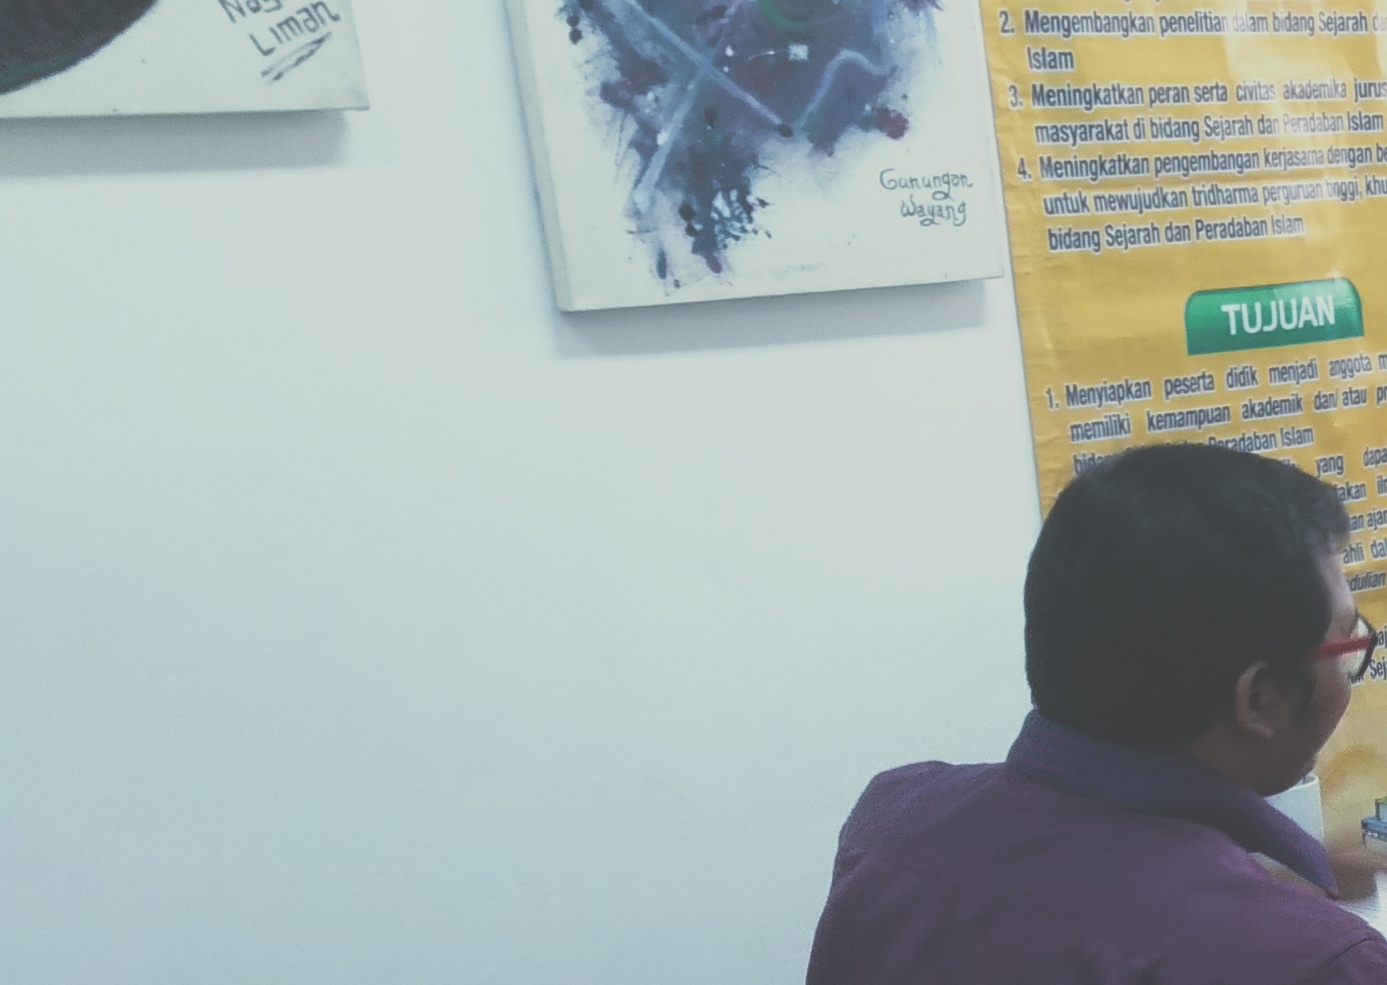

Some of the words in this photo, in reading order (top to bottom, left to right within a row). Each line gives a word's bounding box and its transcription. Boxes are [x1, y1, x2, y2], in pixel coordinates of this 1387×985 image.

[1000, 11, 1015, 33] 2.
[1024, 10, 1155, 38] Mengembangkan
[1159, 12, 1227, 37] penelitian
[1232, 12, 1268, 33] dalam
[1273, 12, 1315, 36] bidang
[1319, 11, 1368, 36] Sejarah
[1026, 47, 1075, 70] Islam
[1008, 84, 1023, 107] 3.
[1031, 83, 1144, 111] Meningkatkan
[1149, 85, 1190, 108] peran
[1194, 82, 1228, 102] serta
[1236, 80, 1276, 101] civitas
[1282, 78, 1347, 100] akademika
[1035, 119, 1130, 147] masyarakat
[1133, 117, 1145, 139] di
[1150, 117, 1200, 142] bidang
[1204, 115, 1253, 141] Sejarah
[1258, 114, 1280, 134] dan
[1283, 112, 1344, 133] Peradaban
[1347, 111, 1384, 131] Islam
[1017, 157, 1032, 179] 4.
[1039, 153, 1150, 181] Meningkatkan
[1154, 150, 1260, 177] pengembangan
[1263, 147, 1325, 171] kerjasama
[1327, 145, 1373, 168] dengan
[900, 193, 967, 227] Wayang
[1043, 190, 1091, 215] untuk
[1094, 187, 1189, 214] mewujudkan
[1191, 184, 1259, 207] tridharma
[1262, 182, 1324, 206] perguruan
[1326, 175, 1362, 202] tinggi,
[1047, 227, 1100, 252] bidang
[1105, 222, 1161, 250] Sejarah
[1165, 220, 1191, 243] dan
[1195, 216, 1268, 241] Peradaban
[1271, 214, 1304, 235] Islam
[1220, 294, 1336, 336] TUJUAN
[1046, 387, 1059, 409] 1.
[1065, 379, 1152, 408] Menyiapkan
[1164, 371, 1215, 399] peserta
[1226, 365, 1258, 388] didik
[1269, 358, 1318, 385] menjadi
[1328, 354, 1372, 379] anggota
[1070, 412, 1131, 442] memiliki
[1147, 404, 1231, 432] kemampuan
[1241, 393, 1303, 420] akademik
[1342, 386, 1367, 406] atau
[1280, 426, 1314, 447] Islam
[1315, 455, 1344, 479] yang
